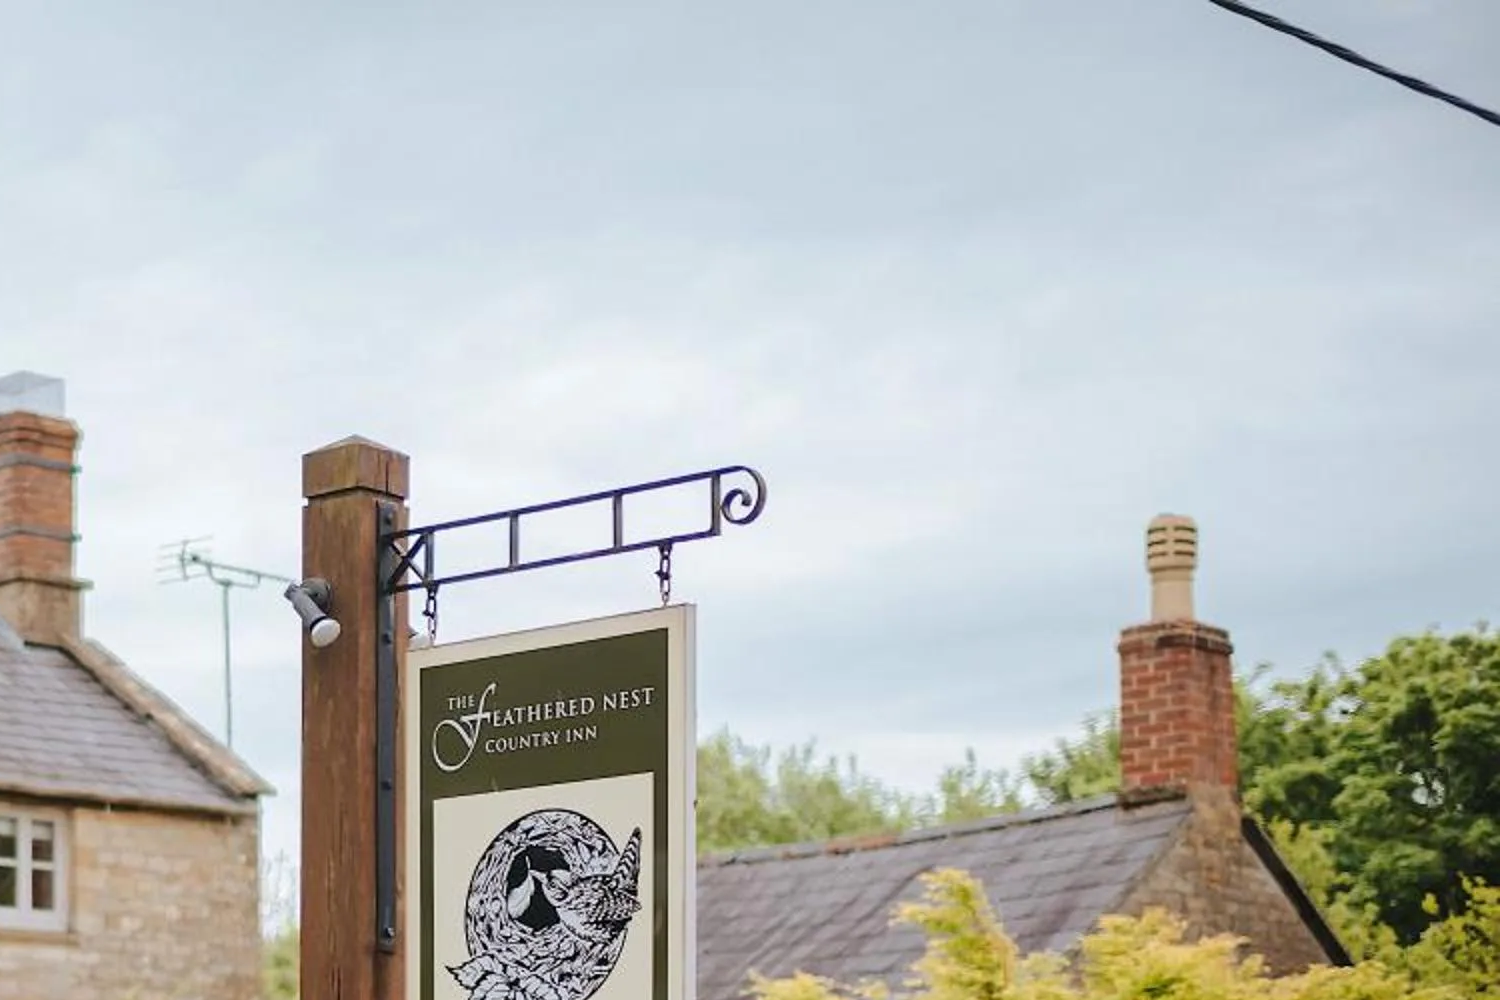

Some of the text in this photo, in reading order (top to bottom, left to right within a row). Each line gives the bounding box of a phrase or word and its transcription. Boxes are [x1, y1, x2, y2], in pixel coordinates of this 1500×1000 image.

[447, 694, 476, 711] THE
[432, 682, 655, 771] FEATHERED NEST
[485, 725, 598, 753] COUNTRY INN
